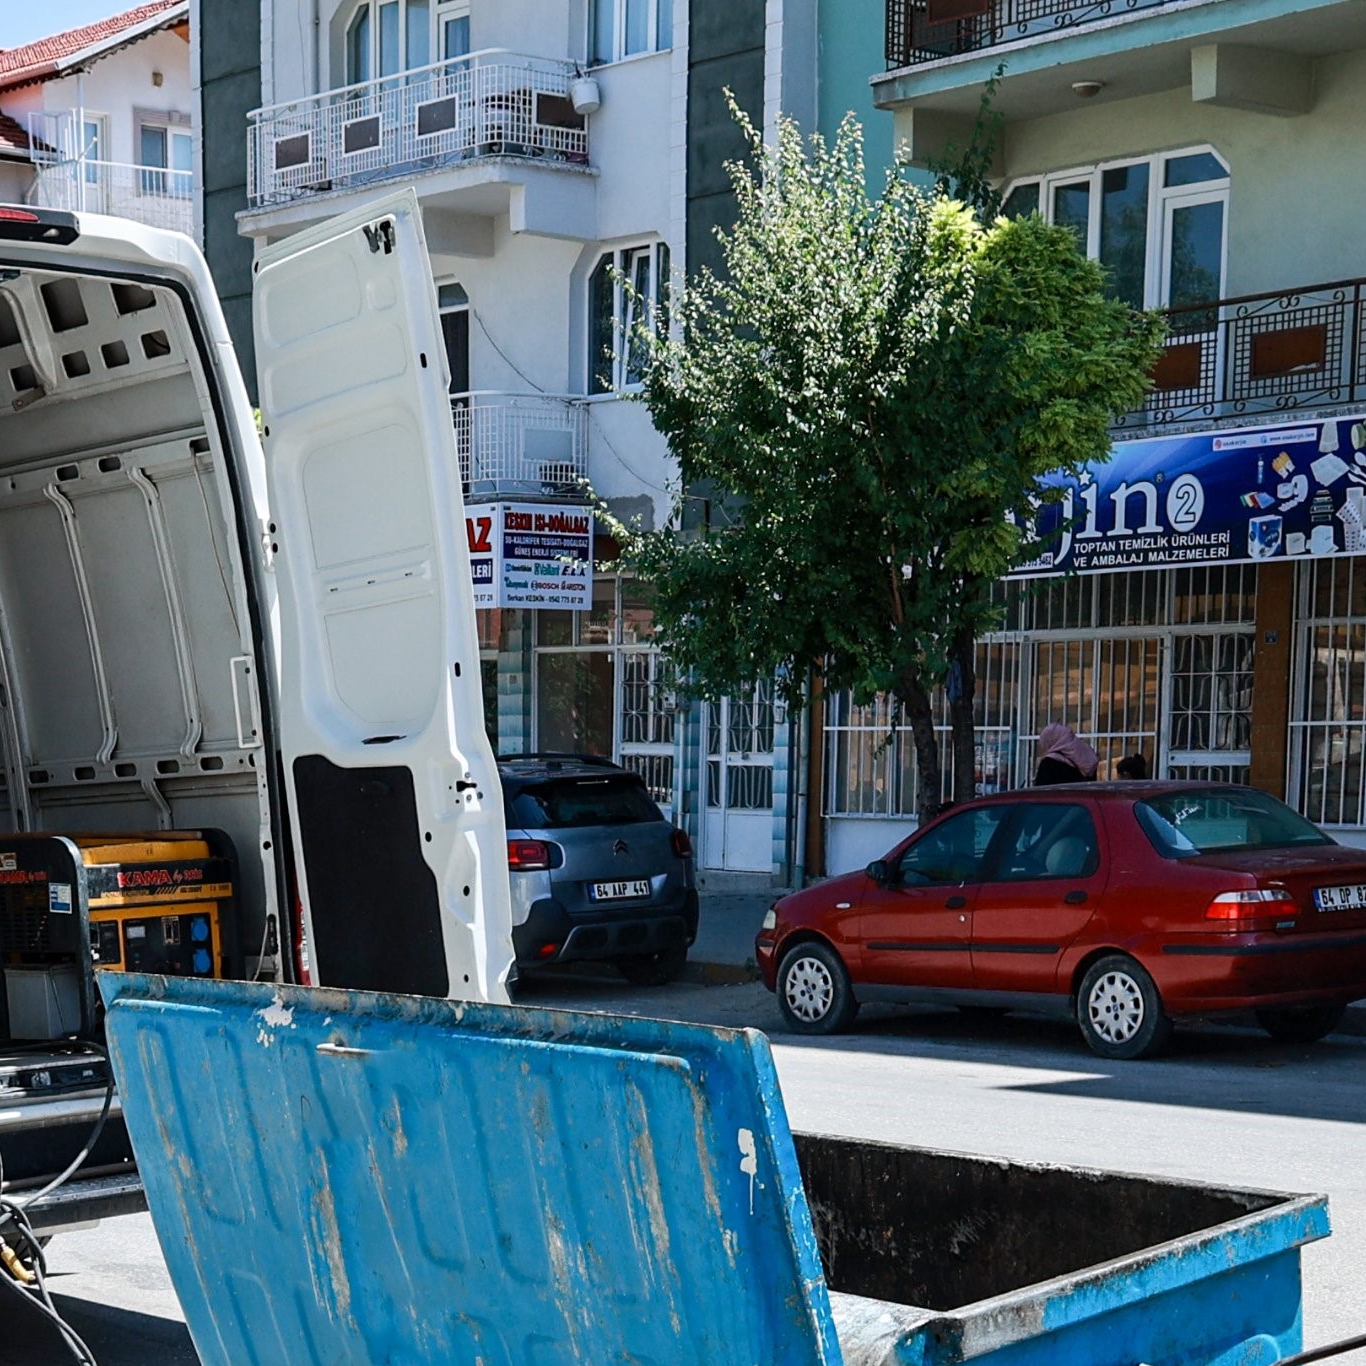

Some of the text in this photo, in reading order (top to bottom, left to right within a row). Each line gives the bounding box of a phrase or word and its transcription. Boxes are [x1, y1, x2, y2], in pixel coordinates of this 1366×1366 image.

[1074, 530, 1230, 554] TOPTAN TEMİZLİK ÜRÜNLERİ
[1073, 544, 1230, 567] VE AMBALAJ MALZEMELERİ
[118, 868, 173, 888] KAMA
[596, 881, 648, 898] 64 AAP 441
[1321, 888, 1335, 905] 64
[1338, 887, 1351, 904] DP
